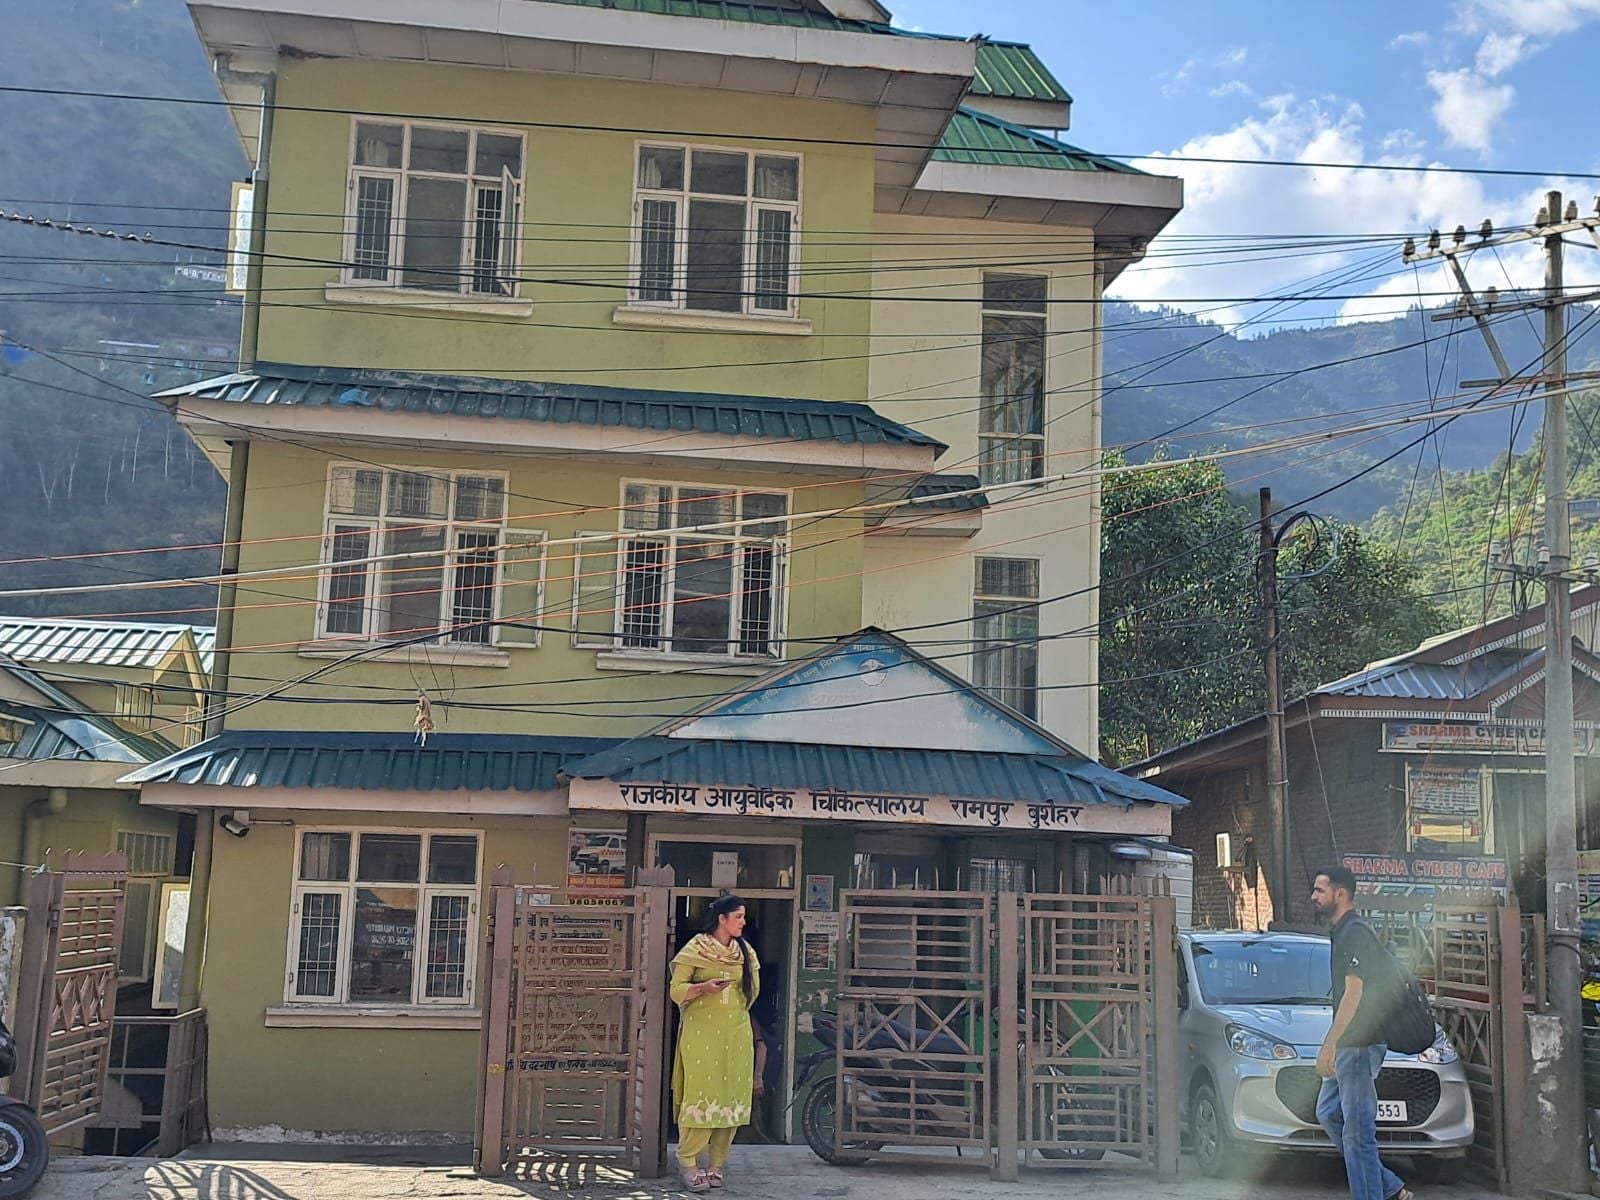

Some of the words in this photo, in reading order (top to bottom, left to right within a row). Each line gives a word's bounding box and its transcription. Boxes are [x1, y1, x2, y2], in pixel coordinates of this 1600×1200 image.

[1408, 725, 1471, 737] SHARMA
[1475, 727, 1526, 738] CYBER
[619, 780, 699, 806] राजकीय
[808, 788, 929, 816] चिकित्सालय
[949, 799, 1014, 826] रामपुर
[1343, 856, 1408, 876] SHARMA
[1412, 859, 1462, 877] CYBER
[1465, 862, 1506, 880] CAFE
[1378, 1104, 1401, 1117] 553
